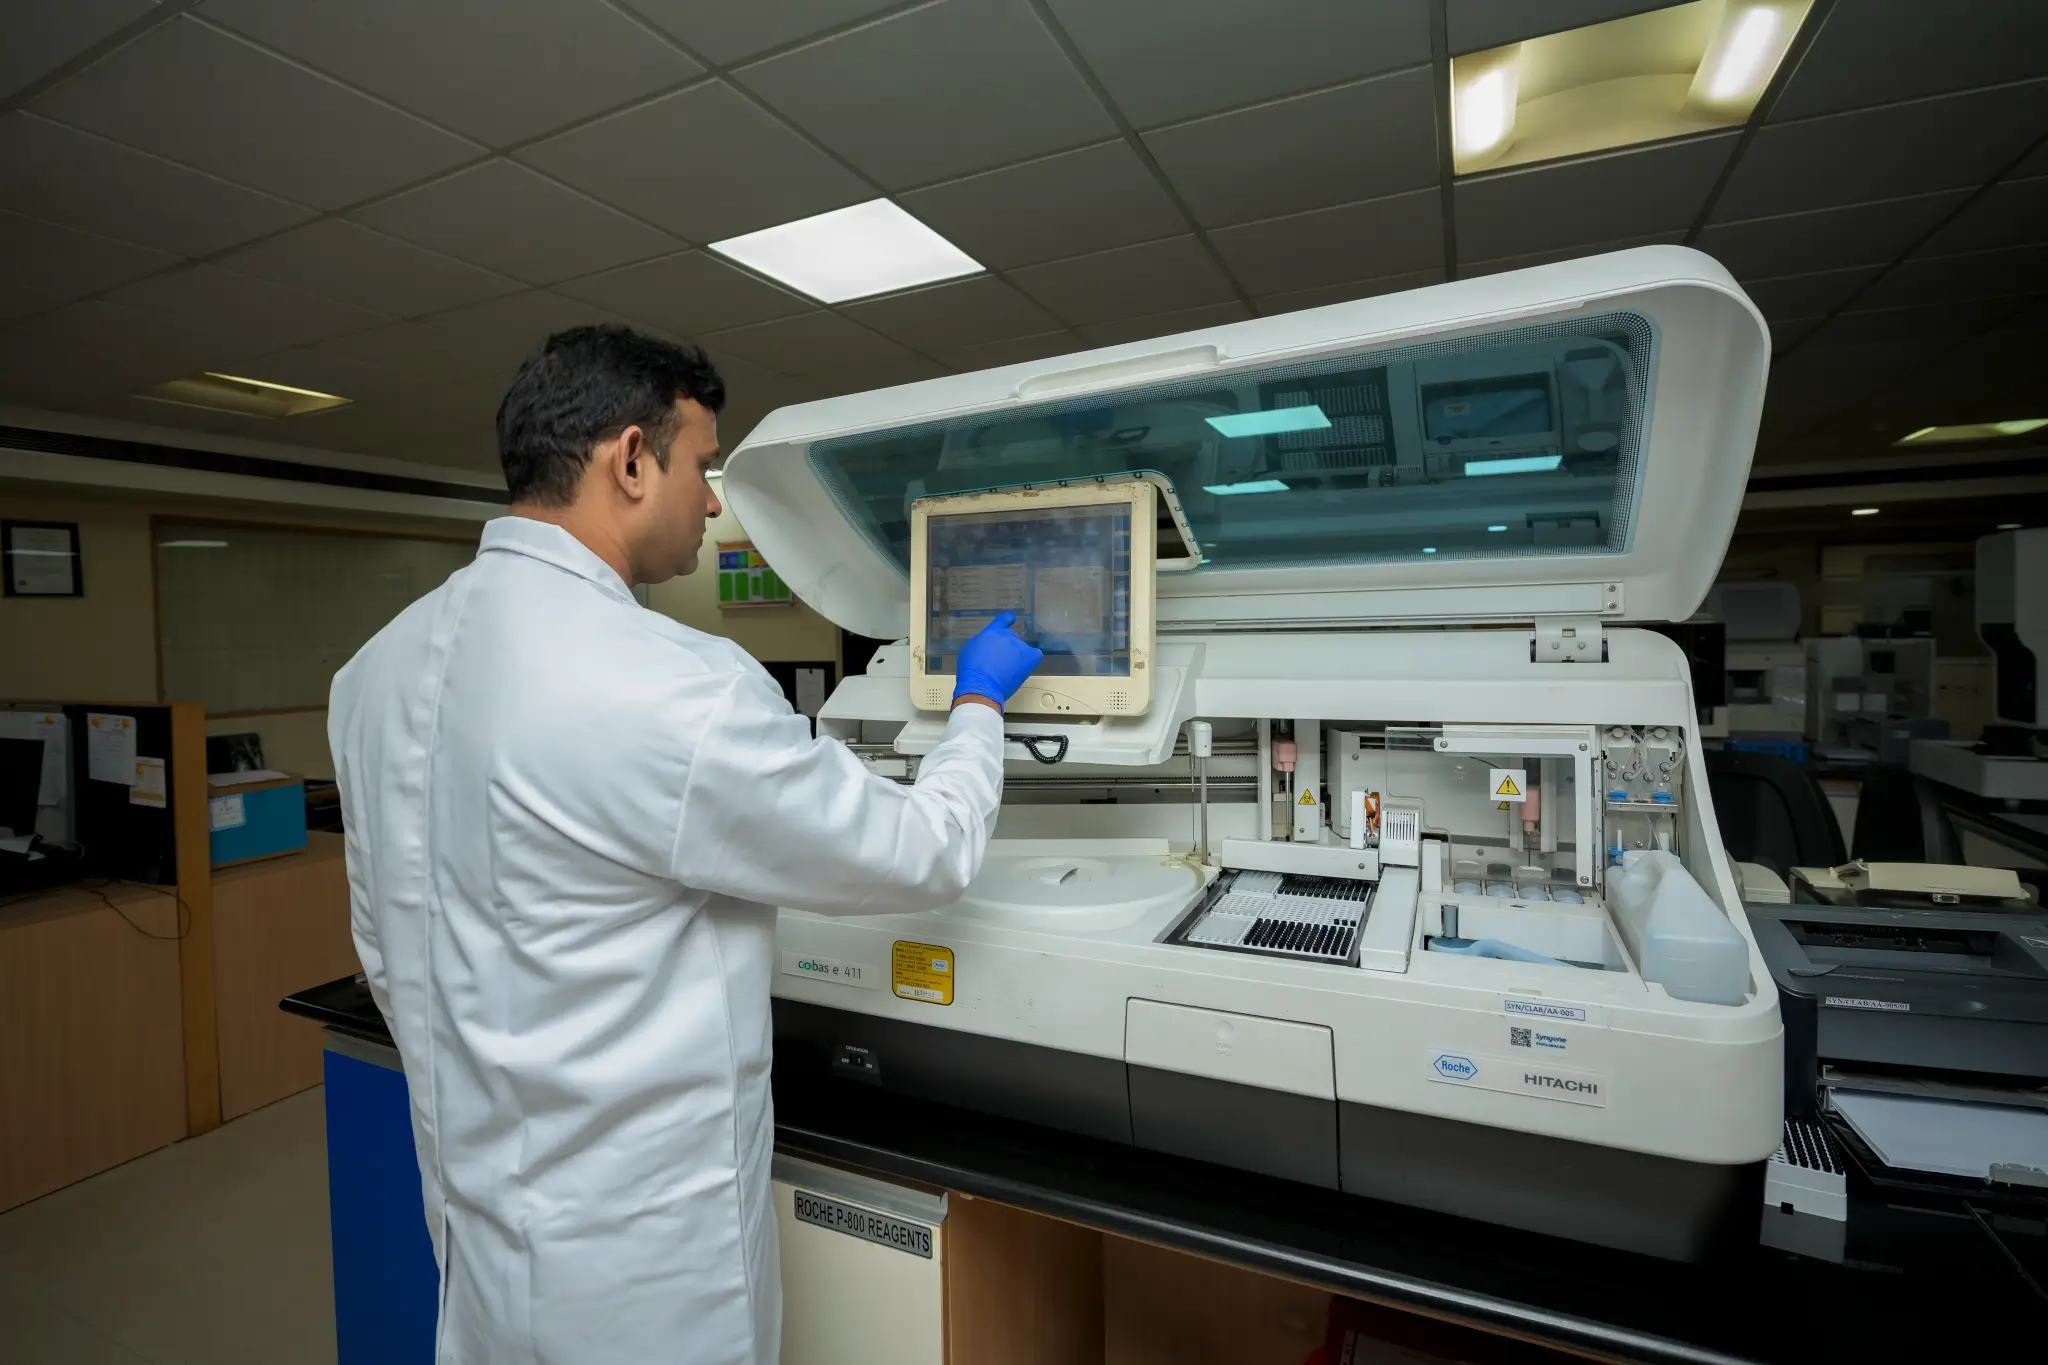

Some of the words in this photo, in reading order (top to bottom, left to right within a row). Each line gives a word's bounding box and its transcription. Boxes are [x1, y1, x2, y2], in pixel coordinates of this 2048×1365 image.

[798, 960, 829, 974] cobas
[833, 966, 839, 975] e
[844, 966, 861, 979] 411
[1506, 1002, 1575, 1017] SYN/CLAB/AA-005
[1827, 998, 1908, 1010] SYN/CLAB/AA-005/01
[1441, 1060, 1471, 1074] Roche
[1524, 1073, 1598, 1095] HITACHI
[797, 1197, 834, 1224] ROCHE
[836, 1208, 865, 1233] P-800
[868, 1217, 930, 1252] REAGENTS
